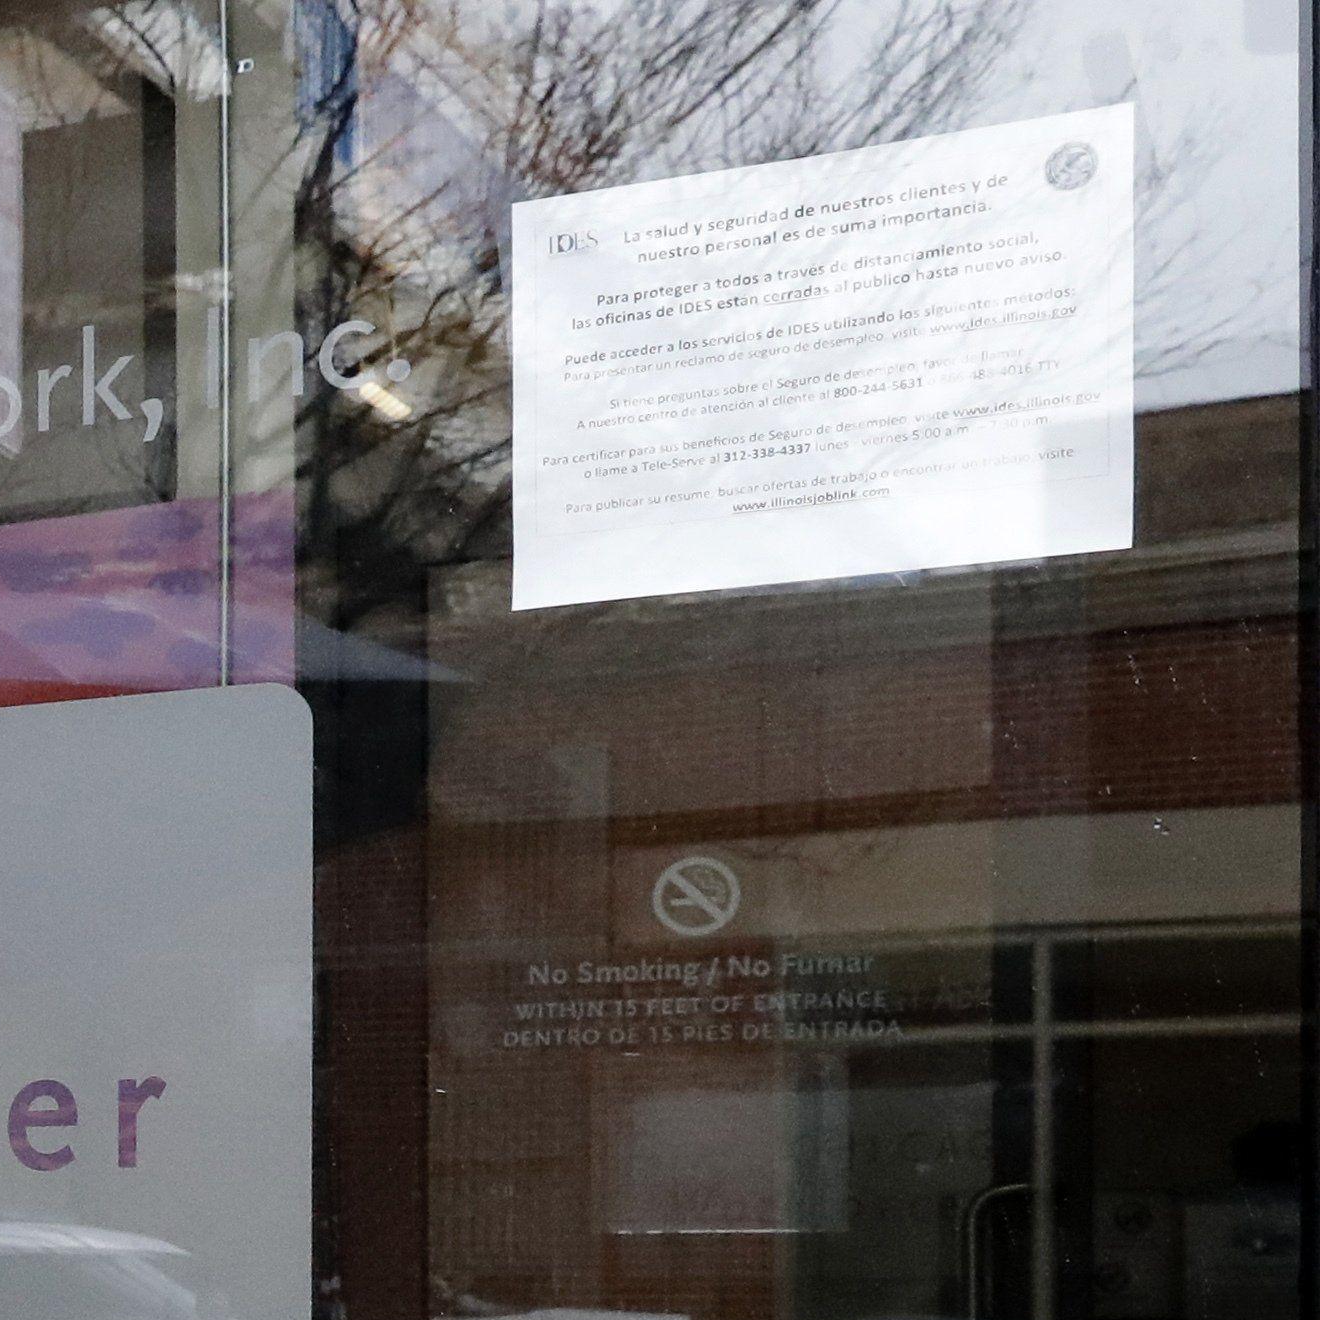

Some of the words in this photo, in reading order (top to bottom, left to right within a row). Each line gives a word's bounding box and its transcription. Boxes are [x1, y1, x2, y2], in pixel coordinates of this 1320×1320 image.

[623, 228, 640, 244] La
[645, 221, 688, 240] salud
[707, 205, 788, 234] seguridad
[794, 202, 815, 218] de
[820, 192, 893, 214] nuestros
[899, 178, 965, 202] clientes
[986, 172, 1008, 189] de
[548, 228, 598, 255] IDES
[637, 242, 699, 264] nuestro
[705, 230, 777, 256] personal
[782, 229, 799, 242] es
[805, 223, 826, 239] de
[831, 217, 876, 235] suma
[881, 197, 992, 230] importancia.
[596, 290, 628, 307] Para
[633, 280, 698, 304] proteger
[715, 271, 758, 290] todos
[777, 261, 825, 281] través
[829, 257, 848, 274] de
[853, 238, 983, 270] distanciamiento
[987, 230, 1039, 251] social,
[571, 315, 591, 330] las
[595, 306, 651, 327] oficinas
[655, 303, 673, 318] de
[679, 297, 712, 315] IDES
[763, 281, 829, 304] cerradas
[915, 263, 958, 282] hasta
[964, 256, 1014, 275] nuevo
[564, 349, 606, 366] Puede
[609, 341, 663, 360] acceder
[678, 336, 698, 351] los
[701, 328, 762, 348] servicios
[766, 325, 783, 339] de
[787, 320, 819, 336] IDES
[823, 309, 894, 331] utilizando
[898, 306, 919, 321] los
[206, 306, 412, 410] Inc.
[563, 369, 590, 383] Para
[593, 361, 652, 380] presentar
[655, 360, 671, 371] un
[674, 351, 725, 368] reclamo
[728, 349, 745, 362] de
[747, 344, 790, 361] seguro
[793, 340, 809, 353] de
[588, 414, 634, 428] nuestro
[772, 390, 814, 406] cliente
[657, 386, 719, 406] preguntas
[723, 381, 758, 396] sobre
[776, 372, 820, 391] Seguro
[824, 370, 840, 383] de
[542, 454, 568, 467] Para
[572, 446, 624, 464] certificar
[628, 444, 655, 458] para
[682, 432, 745, 451] beneficios
[749, 430, 764, 443] de
[768, 425, 812, 442] Seguro
[816, 422, 832, 434] de
[594, 463, 627, 478] llame
[723, 442, 810, 463] 312-338-4337
[565, 501, 591, 514] Para
[595, 496, 643, 512] publicar
[762, 477, 807, 493] ofertas
[811, 475, 827, 487] de
[1038, 446, 1074, 461] visite
[732, 484, 890, 514] www.illinoisjoblink.com
[528, 960, 568, 986] No
[577, 957, 700, 987] Smoking
[728, 955, 771, 979] No
[781, 953, 873, 977] Fumar
[710, 995, 743, 1014] OF
[754, 989, 889, 1013] ENTRANCE
[503, 1027, 601, 1048] DENTRO
[609, 1026, 639, 1046] DE
[683, 1023, 733, 1044] PIES
[783, 1019, 904, 1041] ENTRADA
